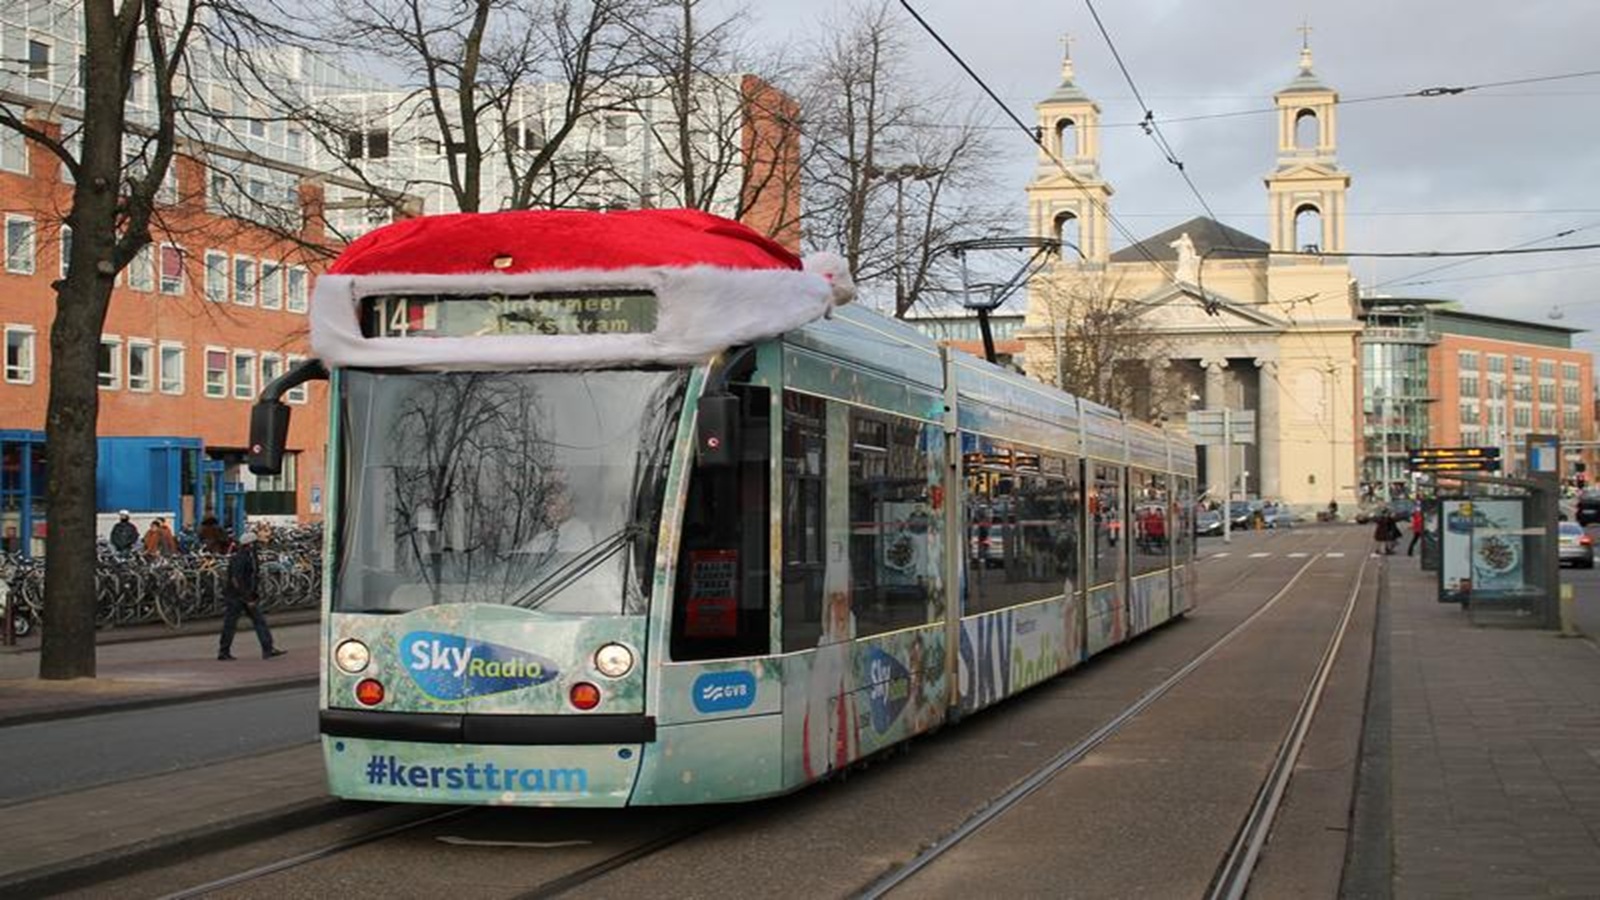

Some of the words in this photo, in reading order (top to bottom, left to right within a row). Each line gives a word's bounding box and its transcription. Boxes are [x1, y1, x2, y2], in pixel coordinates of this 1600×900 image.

[373, 298, 410, 338] 14
[410, 639, 472, 678] Sky
[469, 657, 542, 678] Radio
[724, 683, 747, 698] GVB
[365, 754, 589, 792] #kersttram
